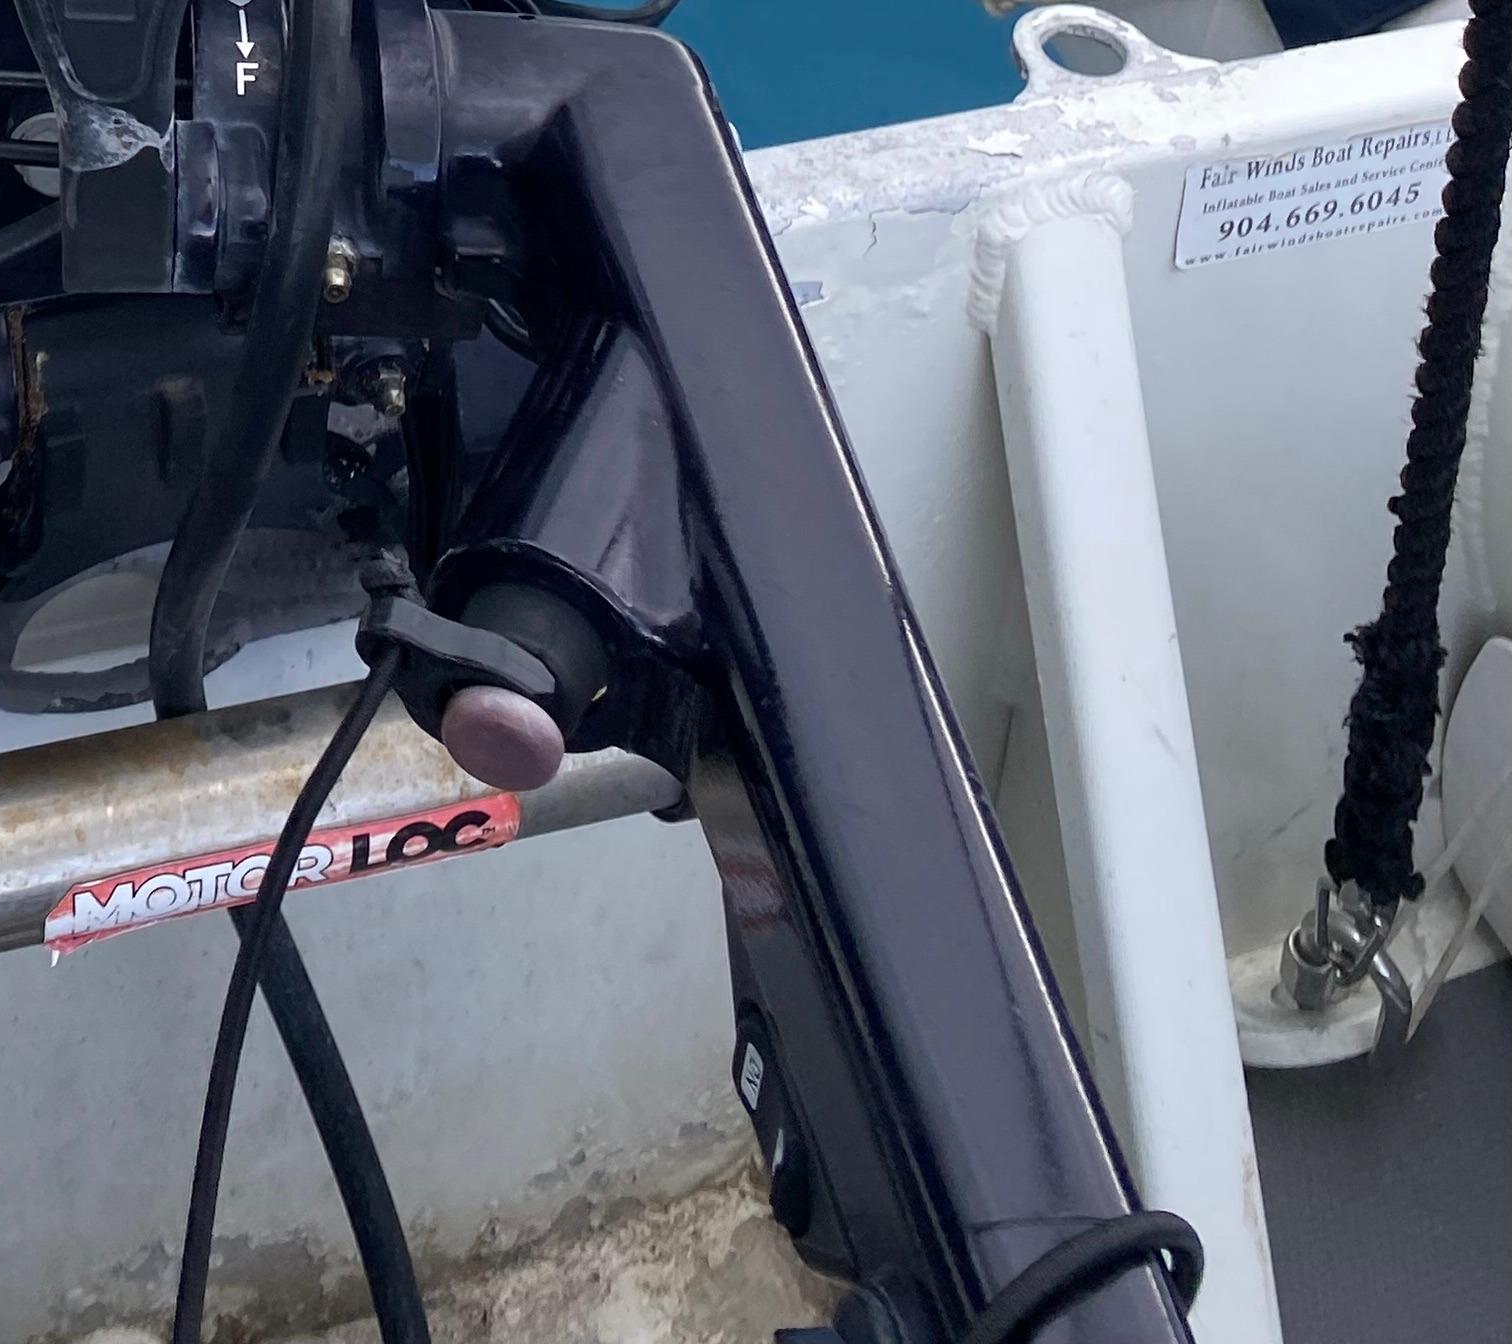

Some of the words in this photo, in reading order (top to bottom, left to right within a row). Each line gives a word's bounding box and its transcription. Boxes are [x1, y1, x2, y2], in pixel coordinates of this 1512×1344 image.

[235, 61, 260, 96] F
[1200, 165, 1238, 190] Fair
[1247, 152, 1305, 181] Winds
[1311, 144, 1353, 168] Boat
[1203, 192, 1265, 215] Inflatable
[1268, 187, 1296, 202] Boat
[1300, 180, 1332, 197] Sales
[1334, 173, 1359, 189] and
[1361, 165, 1407, 184] Service
[1410, 157, 1446, 174] Cente
[1217, 181, 1422, 244] 904.669.6045
[71, 842, 336, 937] MOTOR
[348, 809, 493, 877] LOC
